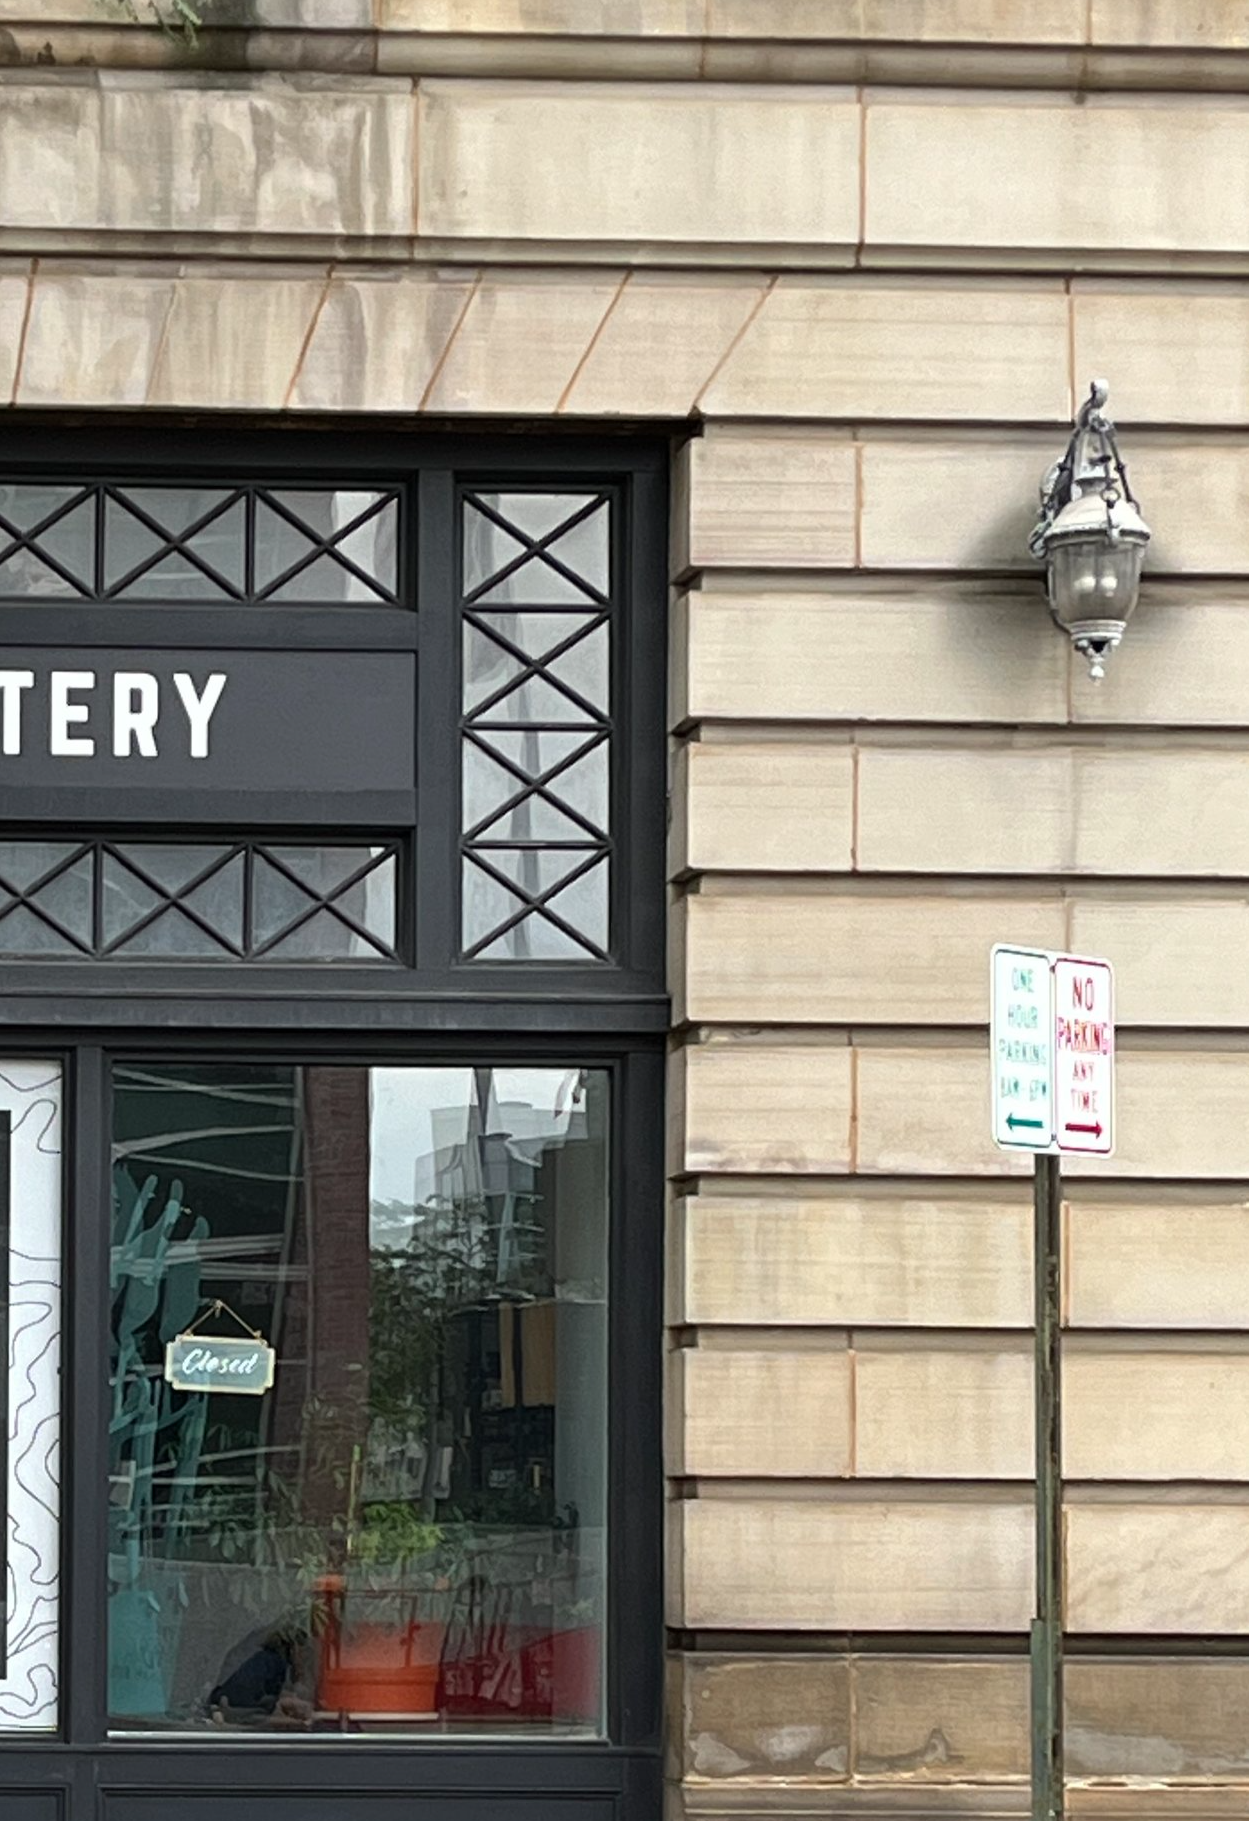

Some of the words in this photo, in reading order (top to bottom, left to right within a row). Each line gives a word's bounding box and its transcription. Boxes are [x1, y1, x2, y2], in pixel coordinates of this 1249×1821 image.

[1012, 967, 1035, 993] ONE
[1072, 976, 1095, 1011] NO
[1008, 1004, 1038, 1029] HOUR
[1057, 1016, 1110, 1056] PARKING
[999, 1038, 1047, 1066] PARKING
[1072, 1060, 1095, 1082] ANY
[1070, 1088, 1099, 1114] TIME
[182, 1348, 259, 1375] Closed
